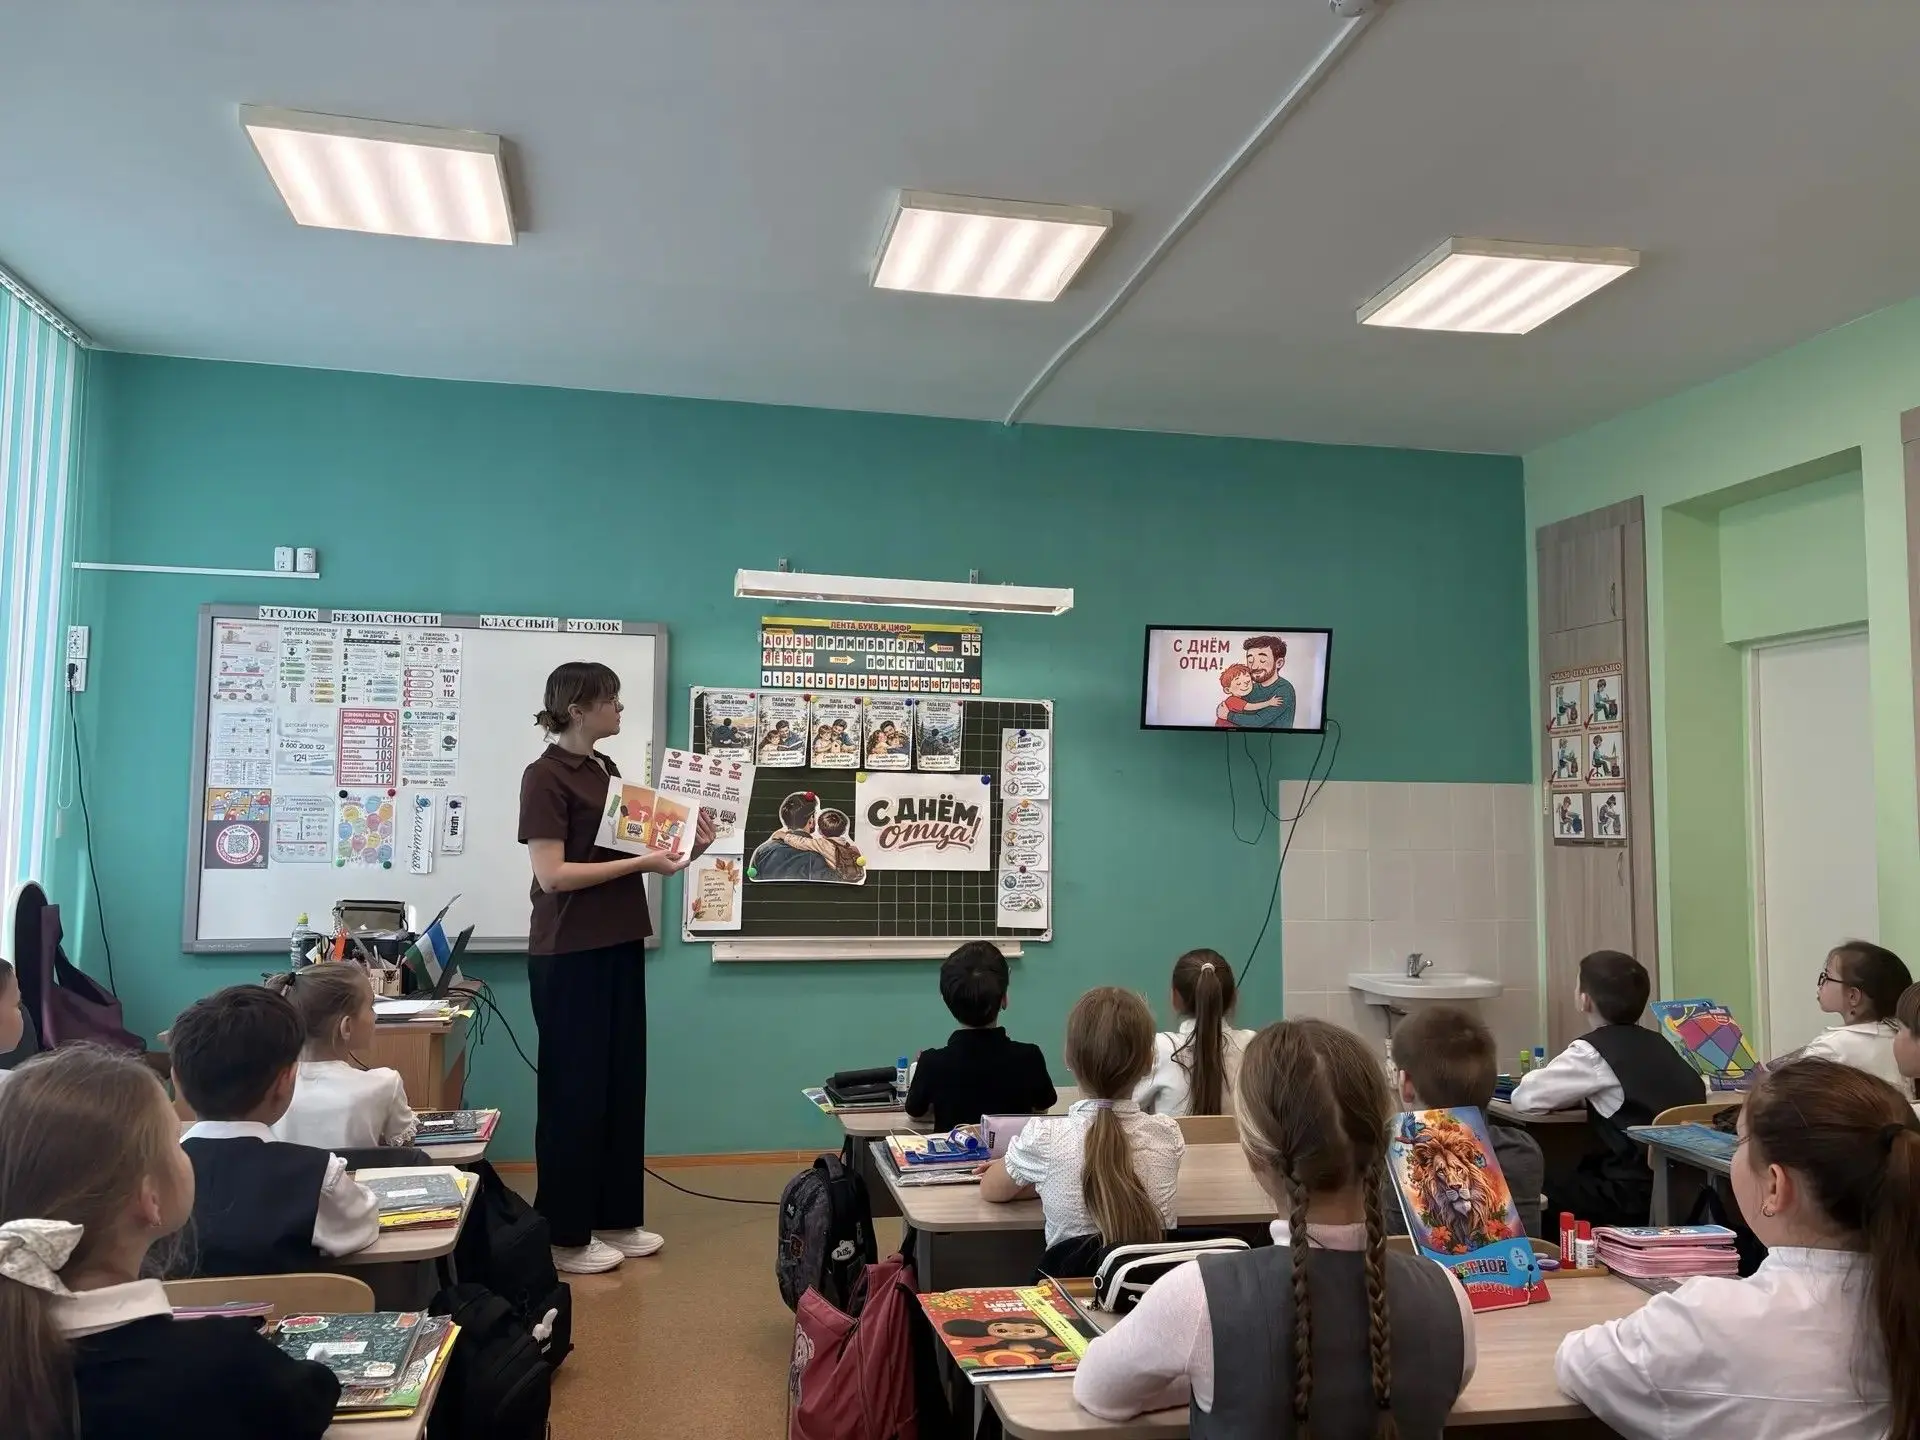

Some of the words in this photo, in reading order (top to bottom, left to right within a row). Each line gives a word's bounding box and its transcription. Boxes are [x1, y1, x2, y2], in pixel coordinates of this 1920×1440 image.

[260, 608, 317, 620] УГОЛОК
[333, 612, 439, 625] БЕЗОПАСНОСТИ
[481, 617, 554, 629] КЛАССНЫЙ
[568, 620, 621, 632] УГОЛОК
[831, 621, 856, 629] ЛЕНТА
[858, 622, 879, 630] БУКВ
[888, 624, 912, 632] ЦИФР
[764, 636, 772, 645] А
[776, 636, 782, 645] О
[786, 636, 792, 646] У
[796, 637, 801, 646] Э
[805, 638, 813, 646] Ы
[816, 636, 824, 647] Й
[828, 638, 833, 647] Р
[836, 638, 843, 648] Л
[847, 638, 854, 648] М
[858, 639, 864, 649] Н
[868, 639, 874, 649] Б
[878, 640, 884, 649] В
[889, 640, 895, 650] Г
[898, 641, 904, 650] З
[907, 641, 915, 652] Д
[916, 642, 925, 651] Ж
[1173, 640, 1183, 653] С
[1187, 637, 1230, 654] ДНЁМ
[868, 658, 874, 667] П
[876, 658, 884, 667] Ф
[888, 659, 894, 668] К
[899, 659, 904, 668] С
[909, 659, 915, 668] Т
[916, 660, 925, 669] Ш
[926, 660, 934, 670] Ц
[938, 661, 943, 670] Ч
[946, 660, 954, 672] Щ
[957, 661, 963, 670] Х
[1179, 656, 1224, 672] ОТЦА!
[1573, 663, 1621, 677] ПРАВИЛЬНО
[442, 675, 455, 683] 101
[376, 726, 393, 737] 101
[376, 737, 393, 748] 102
[293, 754, 306, 762] 124
[375, 750, 392, 760] 103
[375, 761, 392, 771] 104
[374, 773, 392, 784] 112
[661, 783, 680, 792] ПАПА
[682, 786, 701, 796] ПАПА
[702, 790, 720, 800] ПАПА
[722, 794, 740, 803] ПАПА
[867, 800, 890, 827] С
[894, 794, 979, 827] ДНЁМ
[450, 816, 459, 836] ЦЕНА
[1466, 1282, 1514, 1296] КАРТОН
